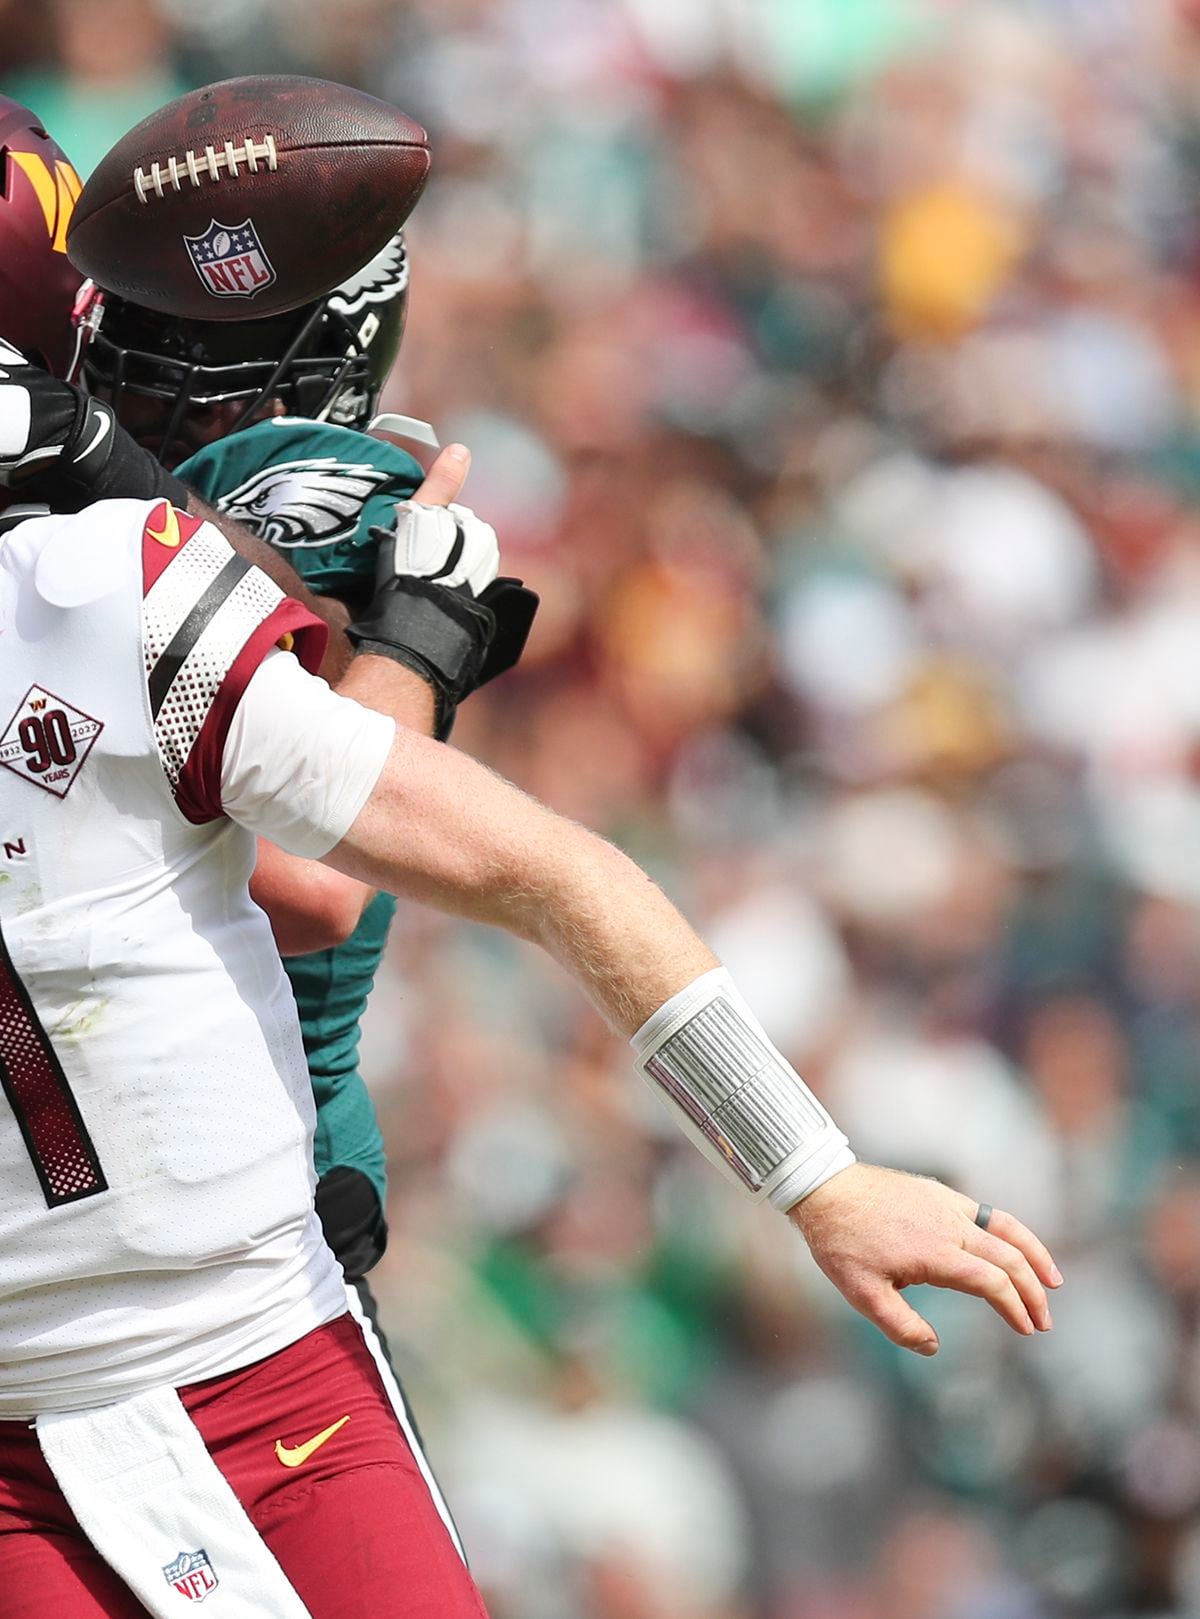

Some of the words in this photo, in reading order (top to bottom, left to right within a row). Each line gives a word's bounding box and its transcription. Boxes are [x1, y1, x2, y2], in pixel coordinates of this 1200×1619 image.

[203, 255, 269, 292] NFL
[18, 709, 77, 773] 90
[71, 723, 98, 738] 2022
[0, 746, 22, 759] 1932
[41, 768, 71, 784] YEARS
[172, 1570, 215, 1600] NFL
